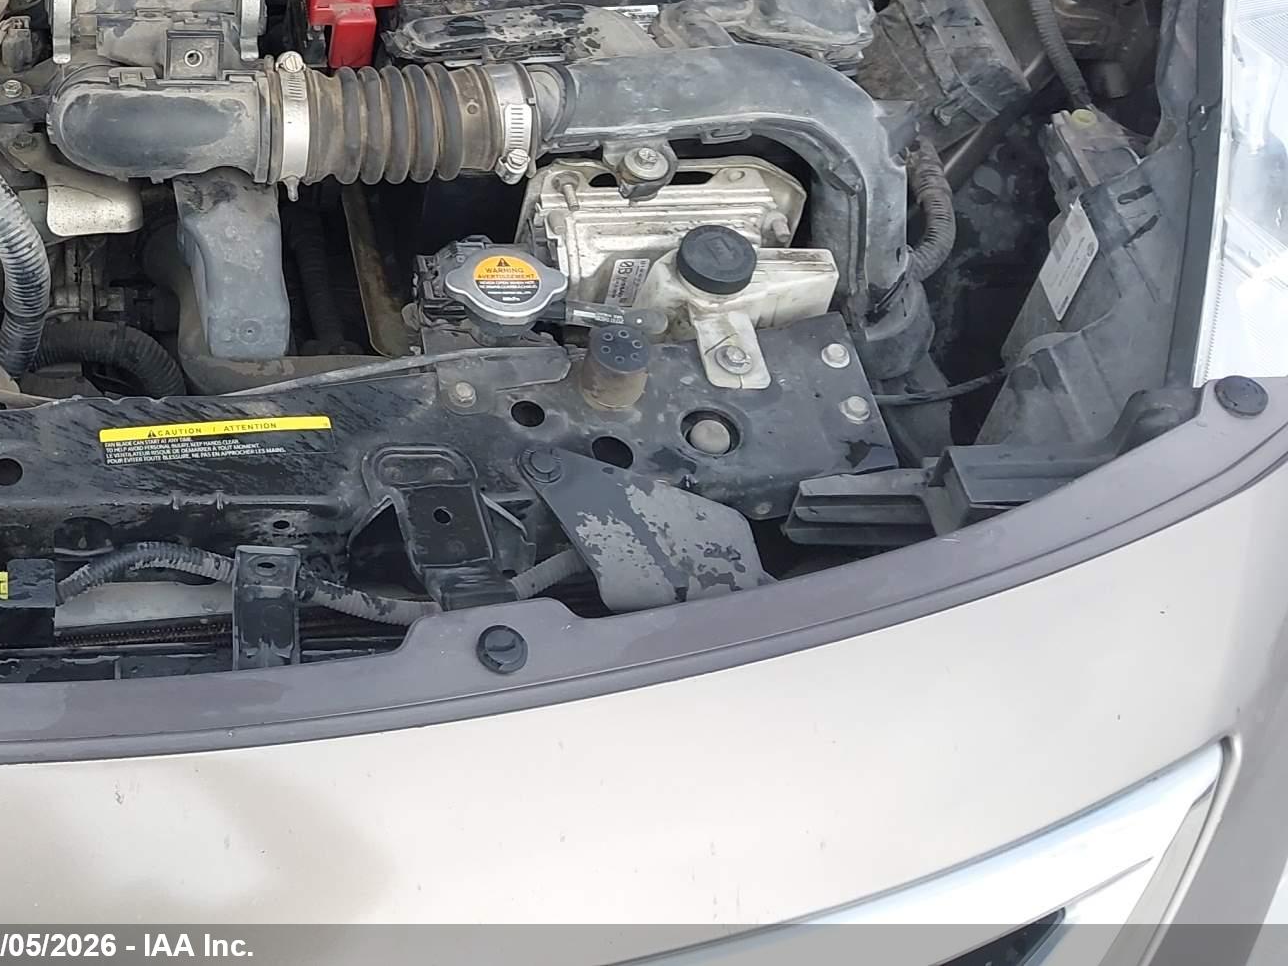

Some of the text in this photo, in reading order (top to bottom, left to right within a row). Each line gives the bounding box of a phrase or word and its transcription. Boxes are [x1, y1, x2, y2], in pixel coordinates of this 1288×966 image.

[157, 427, 202, 437] CAUTION
[223, 422, 277, 432] ATTENTION
[114, 450, 150, 458] VENTILATEUR
[221, 449, 255, 457] APPROCHER
